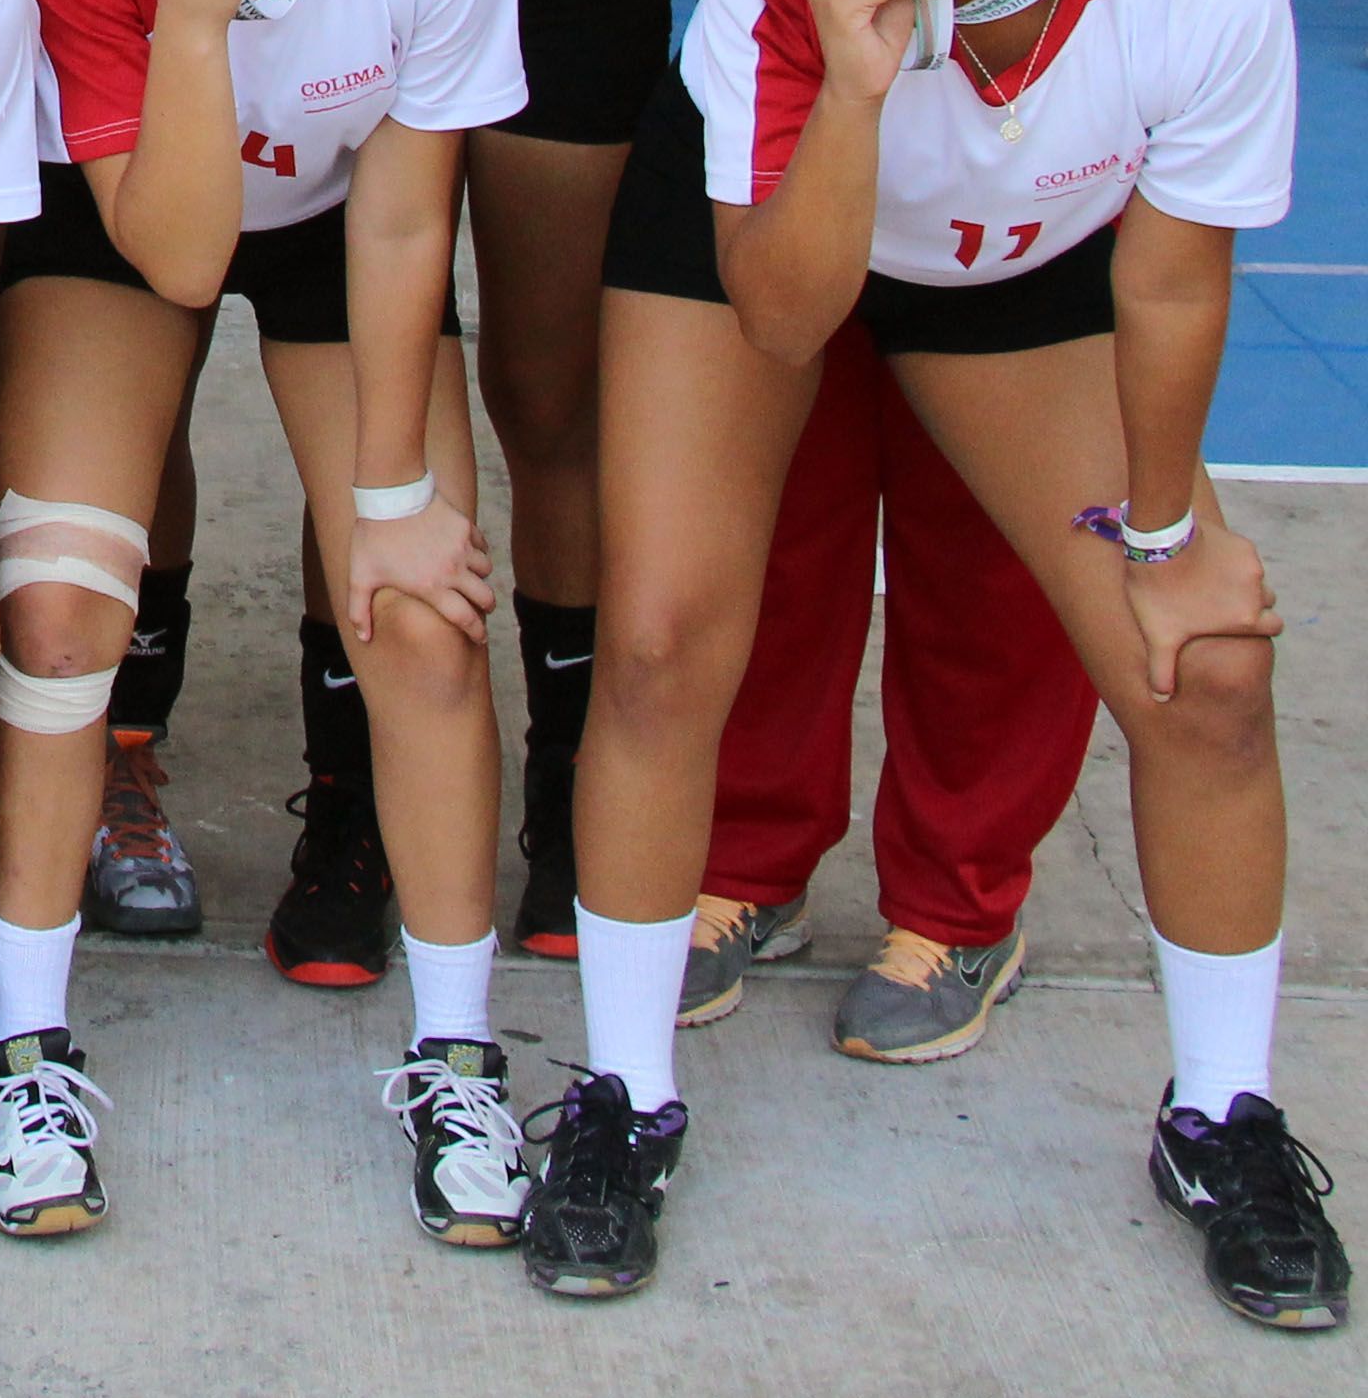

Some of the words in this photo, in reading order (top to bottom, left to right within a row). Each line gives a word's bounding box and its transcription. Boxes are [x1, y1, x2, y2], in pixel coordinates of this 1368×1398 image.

[300, 64, 385, 97] COLIMA
[241, 130, 296, 177] 4
[1035, 154, 1121, 188] COLIMA
[950, 218, 1043, 271] 11
